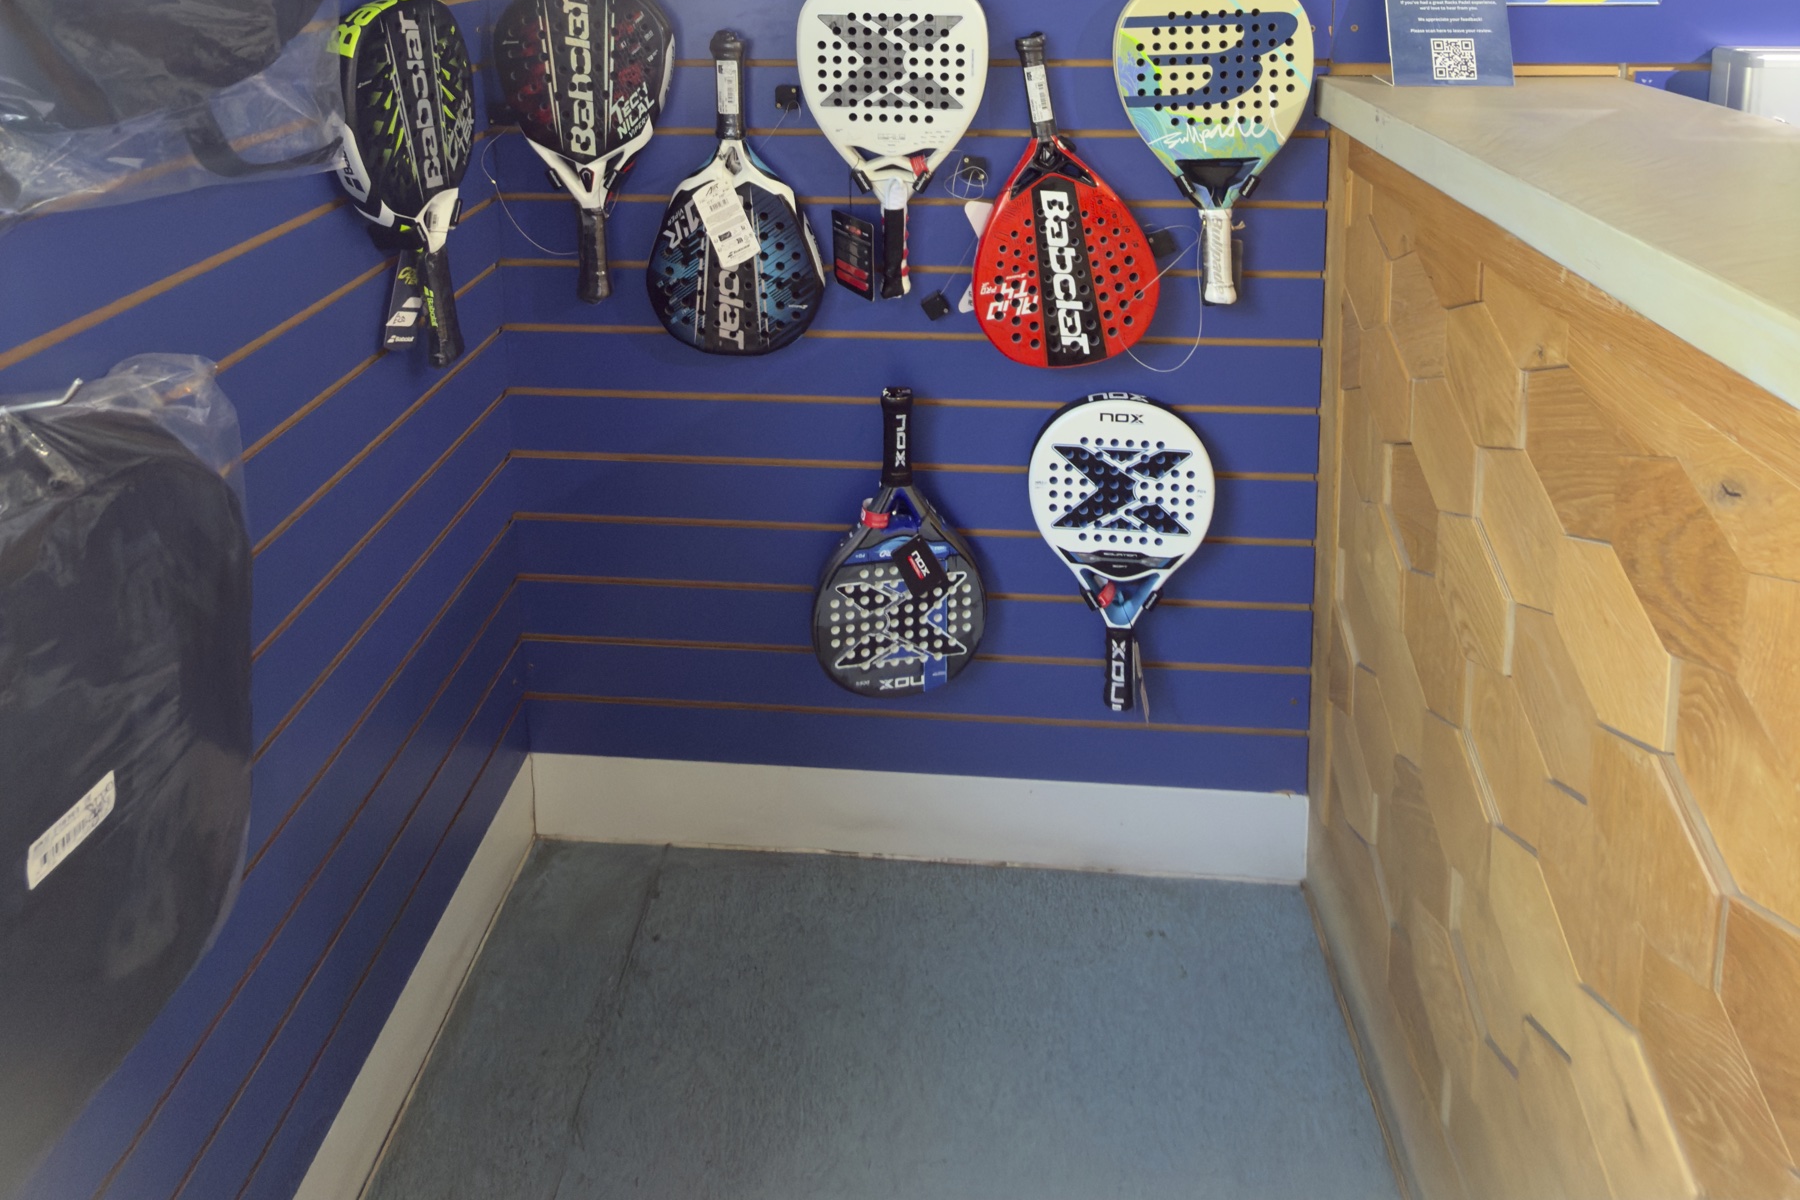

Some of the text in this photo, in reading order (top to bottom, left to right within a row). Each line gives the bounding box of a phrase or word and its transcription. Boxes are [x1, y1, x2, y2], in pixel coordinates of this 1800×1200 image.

[398, 10, 444, 189] Babolat
[610, 81, 649, 124] TECH
[980, 287, 997, 295] PRO
[1039, 189, 1091, 355] Babolat
[427, 297, 439, 328] Babolat
[718, 265, 745, 350] olat
